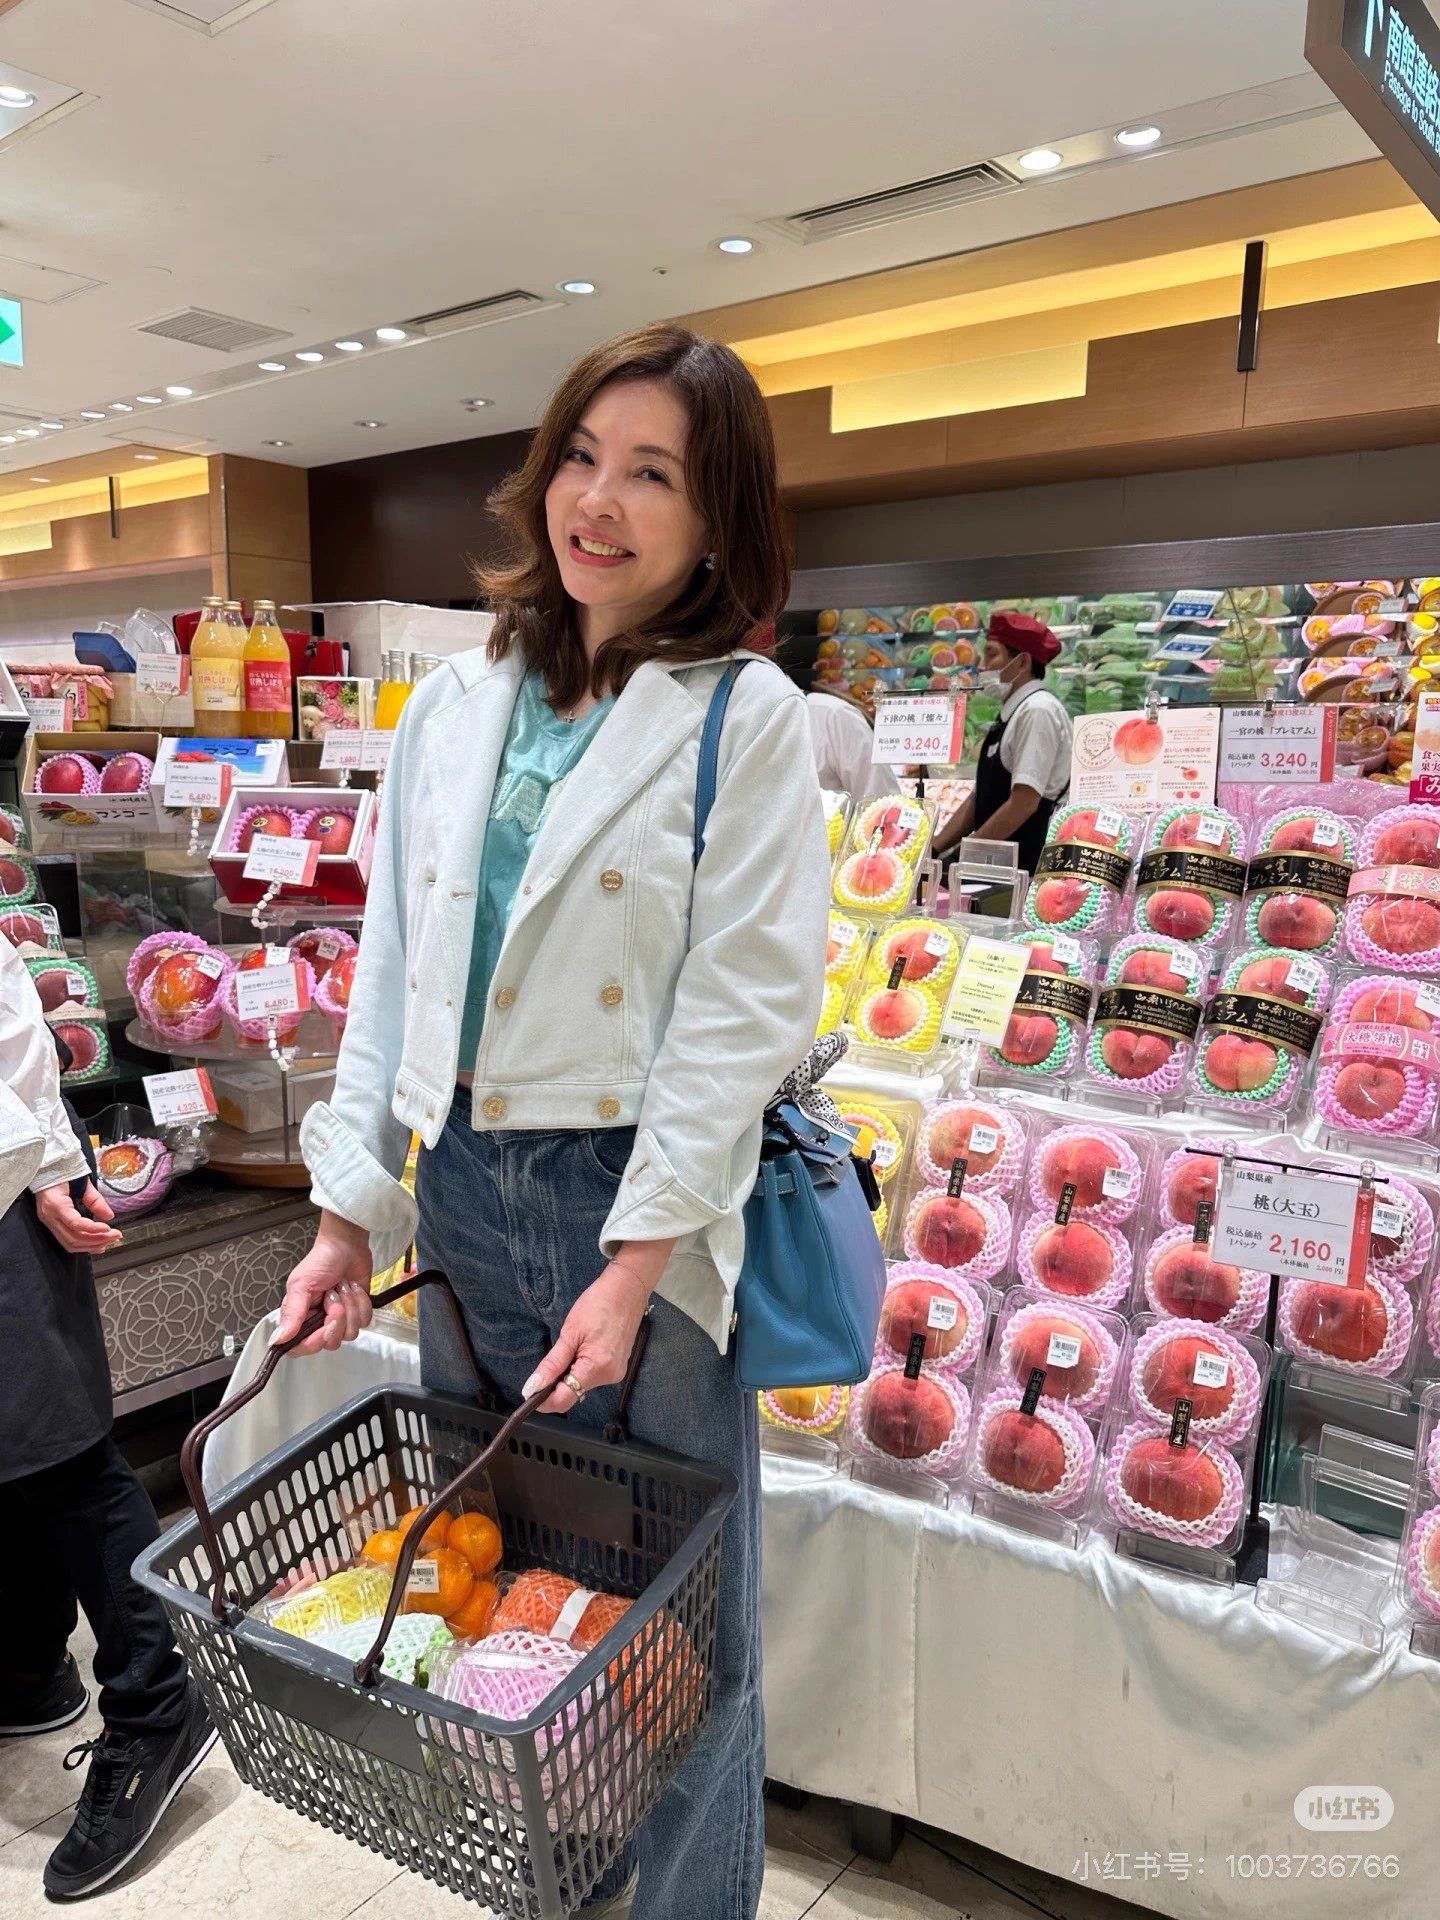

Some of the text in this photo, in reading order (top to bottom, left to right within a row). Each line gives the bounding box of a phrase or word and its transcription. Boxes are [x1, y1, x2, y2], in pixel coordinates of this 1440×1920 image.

[1384, 60, 1411, 114] Passage
[1411, 100, 1418, 123] to
[1418, 108, 1435, 147] South
[1233, 710, 1261, 718] 山梨県産
[1230, 727, 1265, 736] 一宮の桃
[903, 736, 941, 751] 3,240
[1260, 753, 1308, 768] 3,240
[1310, 760, 1319, 768] 円
[1236, 1171, 1273, 1184] 山梨県産
[1253, 1193, 1321, 1219] 桃(大玉)
[1226, 1225, 1346, 1267] 税込価格 2,160 円
[1229, 1238, 1258, 1249] 1パック
[1172, 1402, 1189, 1446] 山梨県産
